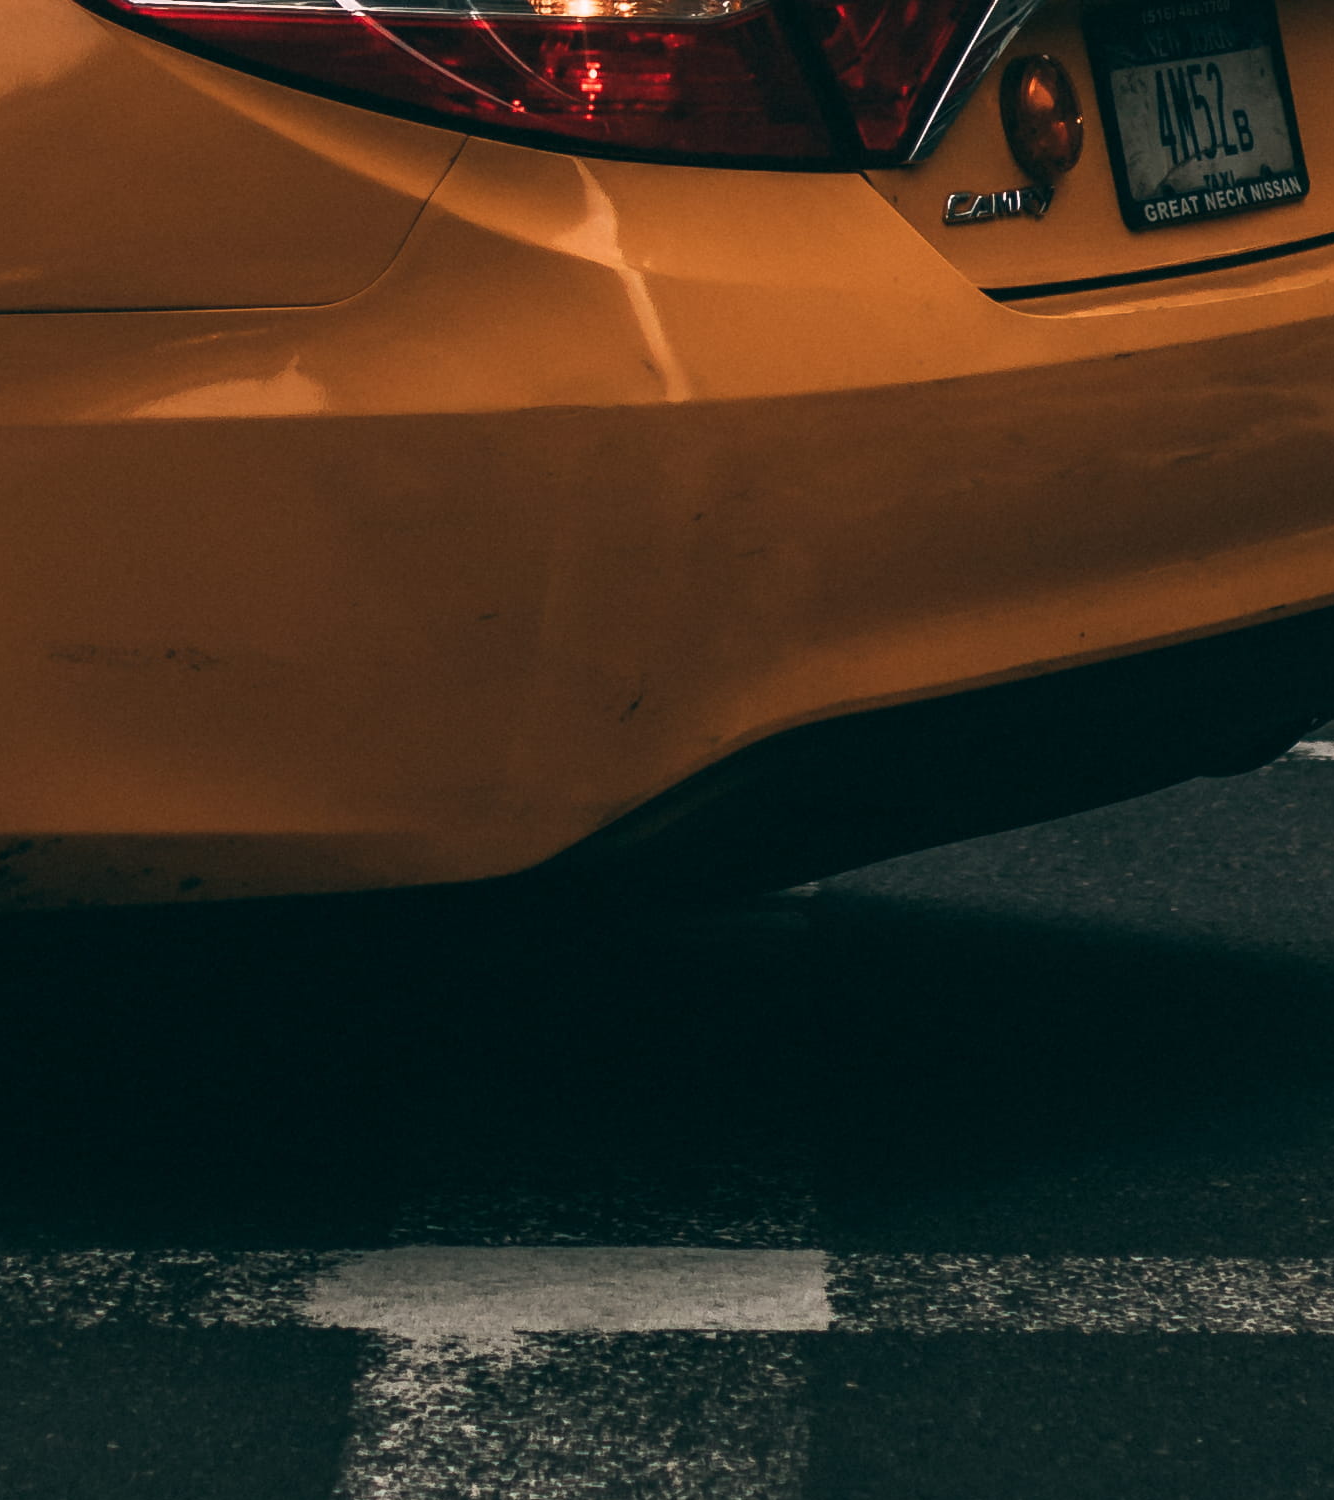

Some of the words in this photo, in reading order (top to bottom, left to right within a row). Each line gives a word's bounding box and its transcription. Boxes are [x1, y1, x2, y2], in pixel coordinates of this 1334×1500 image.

[1143, 194, 1200, 222] GREAT
[1204, 185, 1249, 212] NECK
[1249, 175, 1303, 203] NISSAN
